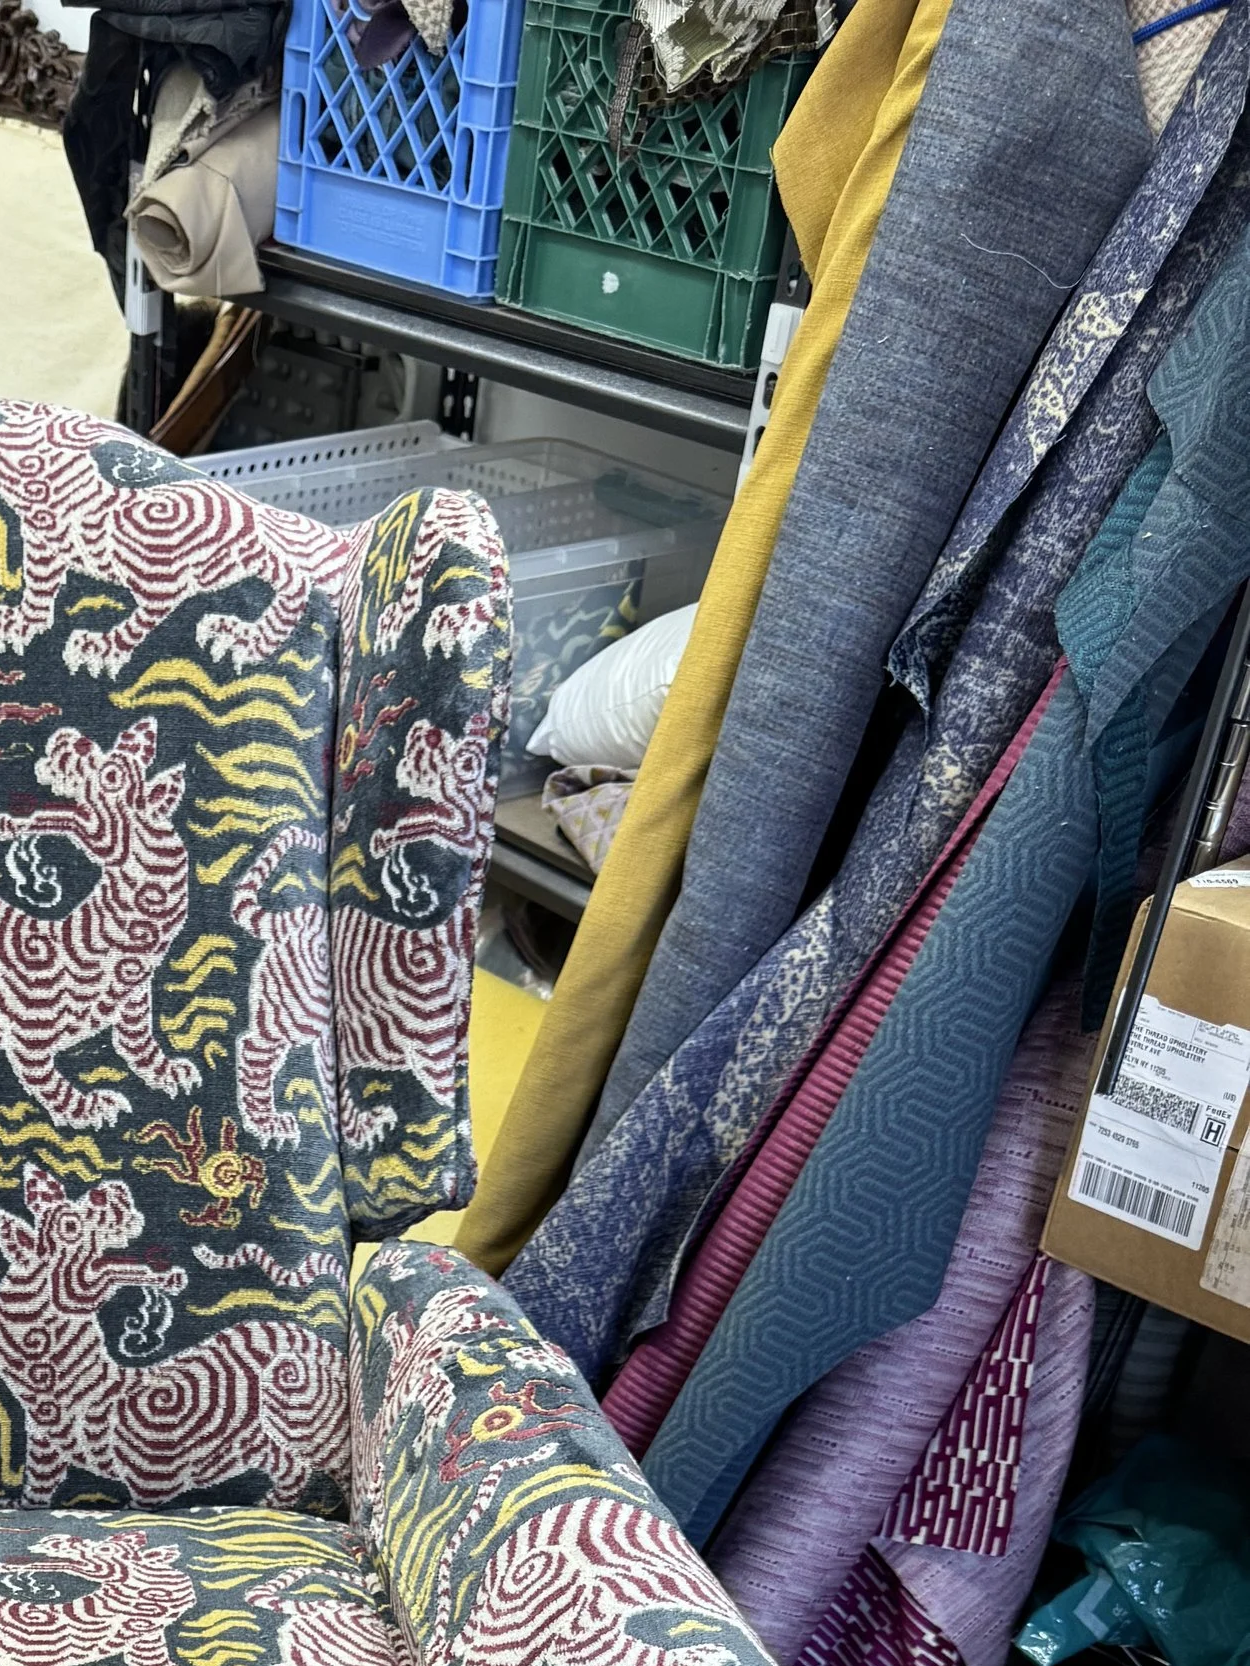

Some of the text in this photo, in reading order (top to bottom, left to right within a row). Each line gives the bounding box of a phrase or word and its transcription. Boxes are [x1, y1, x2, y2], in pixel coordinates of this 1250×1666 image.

[1129, 1041, 1161, 1056] VERLY AVE
[1143, 1036, 1166, 1050] THREAD
[1166, 1045, 1206, 1064] UPHOLSTERY
[1145, 1029, 1168, 1043] THREAD
[1169, 1038, 1208, 1056] UPHOLSTERY
[1223, 1092, 1237, 1103] (US)
[1206, 1105, 1232, 1119] FedEx
[1204, 1121, 1222, 1143] H
[1191, 1181, 1210, 1194] 11205
